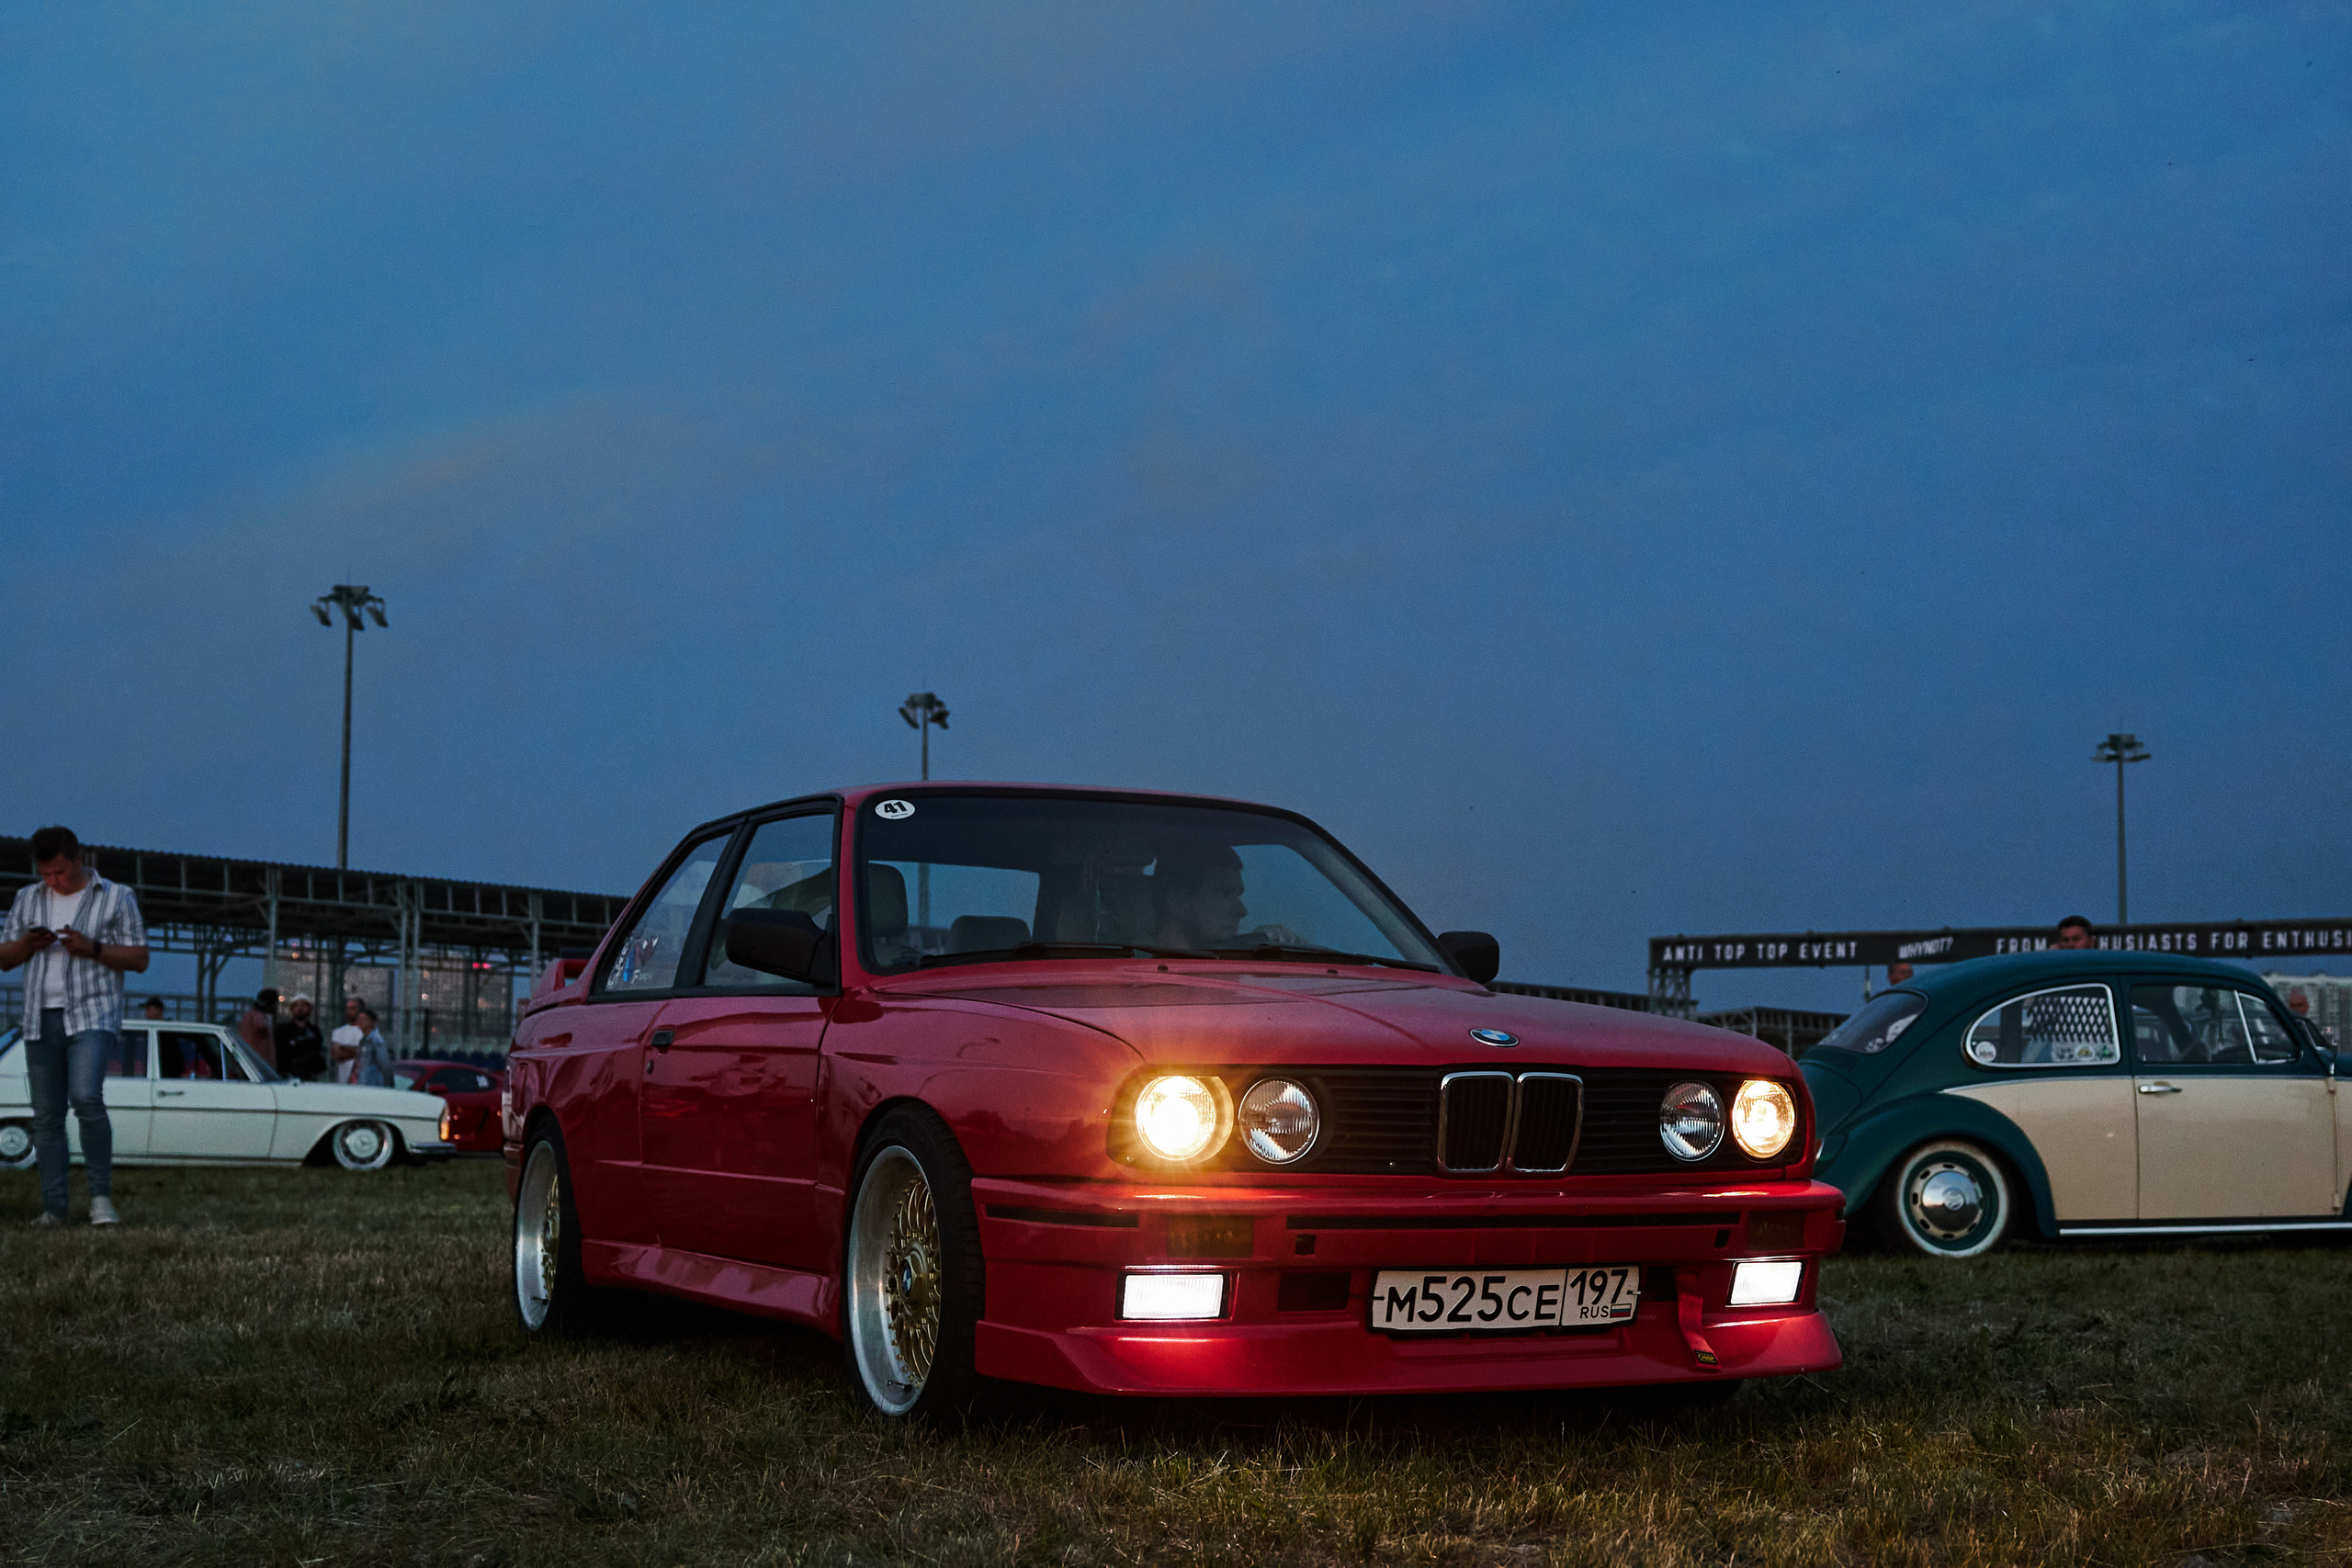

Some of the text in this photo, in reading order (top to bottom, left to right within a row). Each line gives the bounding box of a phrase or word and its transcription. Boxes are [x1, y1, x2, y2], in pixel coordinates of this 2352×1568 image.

[884, 801, 908, 814] 41
[1662, 941, 1858, 961] ANTI TOP TOP EVENT
[1996, 937, 2048, 953] FROM
[2092, 932, 2198, 952] HUSIASTS
[2211, 931, 2249, 950] FOR
[1385, 1269, 1629, 1323] M525CE 197
[1579, 1304, 1610, 1319] RUS
